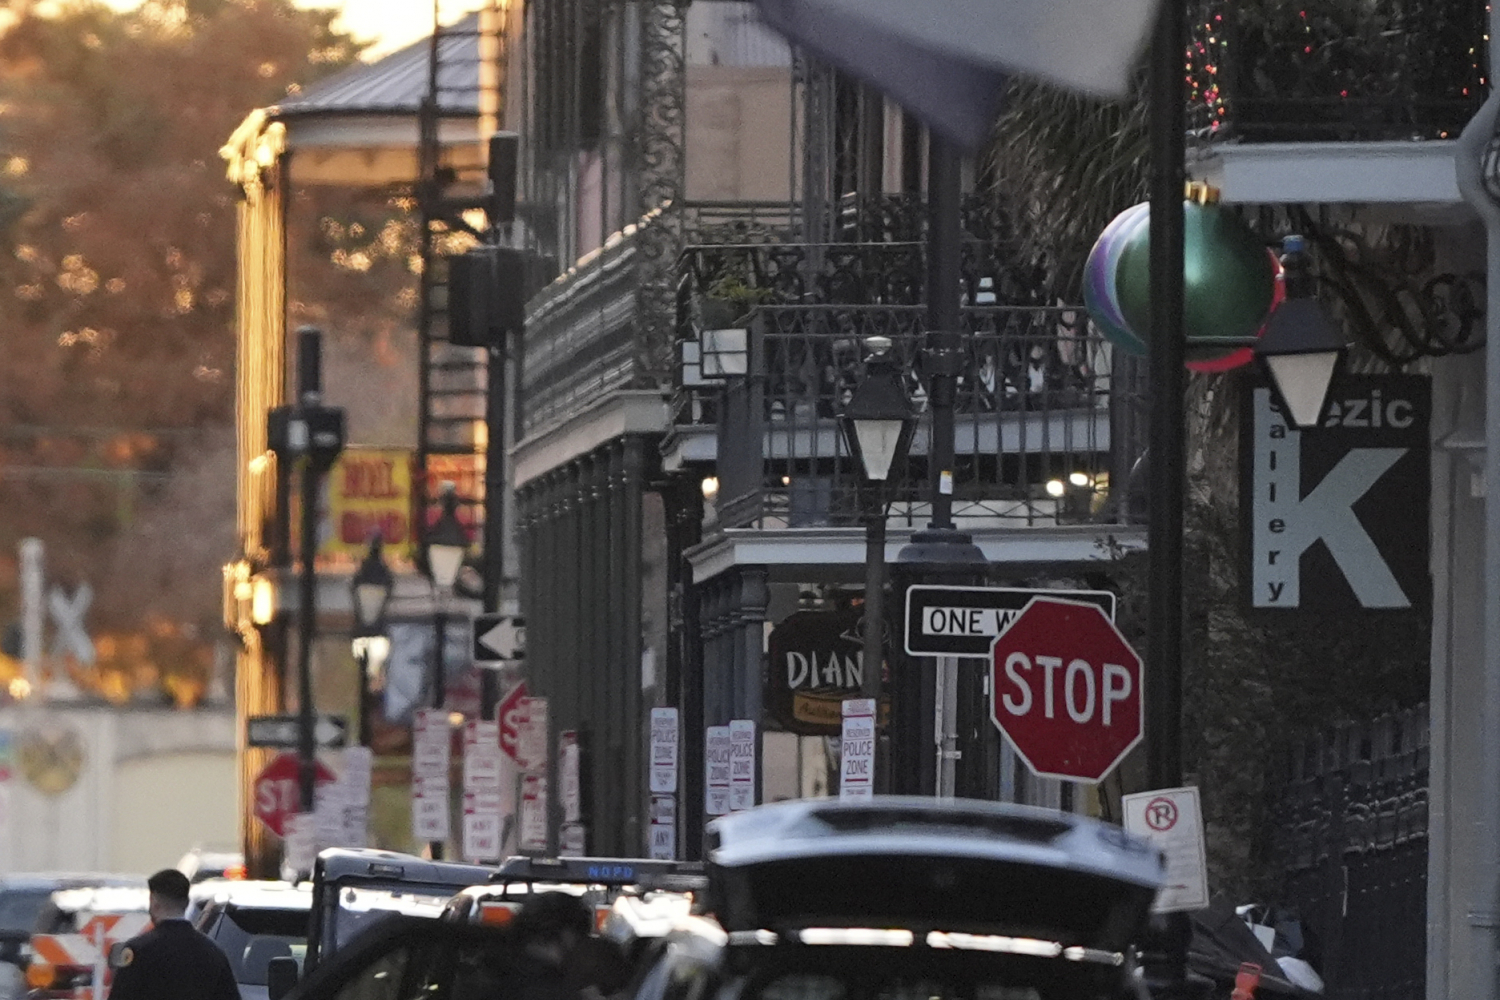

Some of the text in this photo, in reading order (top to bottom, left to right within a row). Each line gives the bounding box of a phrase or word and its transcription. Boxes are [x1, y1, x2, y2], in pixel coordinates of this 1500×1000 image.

[1325, 389, 1414, 429] ezic
[929, 609, 984, 633] ONE
[787, 651, 864, 689] DIAN
[1002, 651, 1132, 727] STOP
[843, 741, 873, 757] POLICE
[845, 760, 868, 775] ZONE
